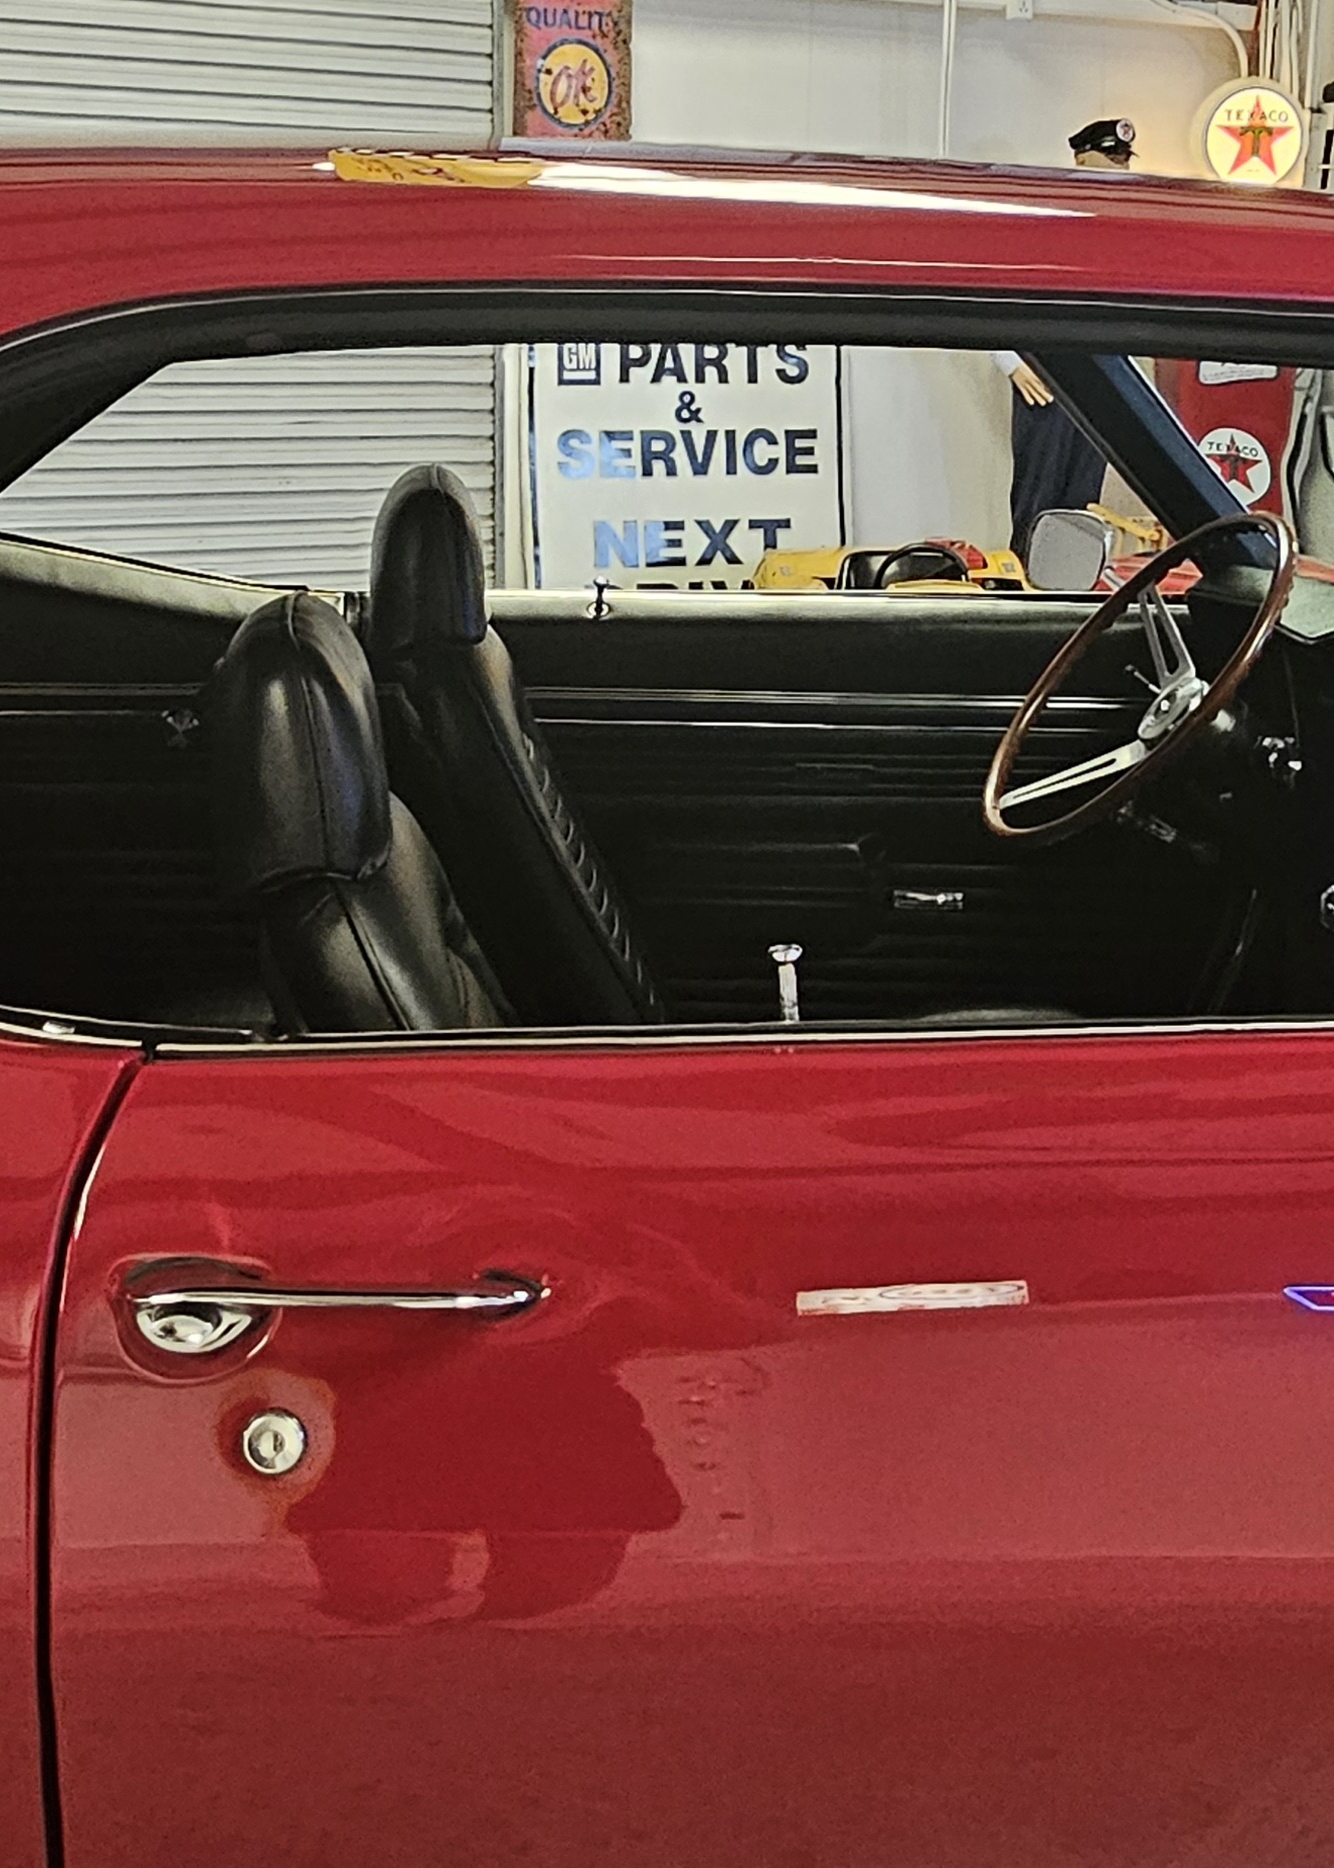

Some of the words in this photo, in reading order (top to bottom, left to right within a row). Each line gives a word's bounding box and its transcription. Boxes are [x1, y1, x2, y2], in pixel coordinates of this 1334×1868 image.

[1224, 109, 1289, 123] TEXACO
[561, 343, 598, 373] GM
[619, 343, 809, 385] PARTS
[675, 390, 704, 424] &
[557, 428, 819, 479] SERVICE
[1208, 441, 1258, 458] TEXACO
[593, 517, 791, 568] NEXT
